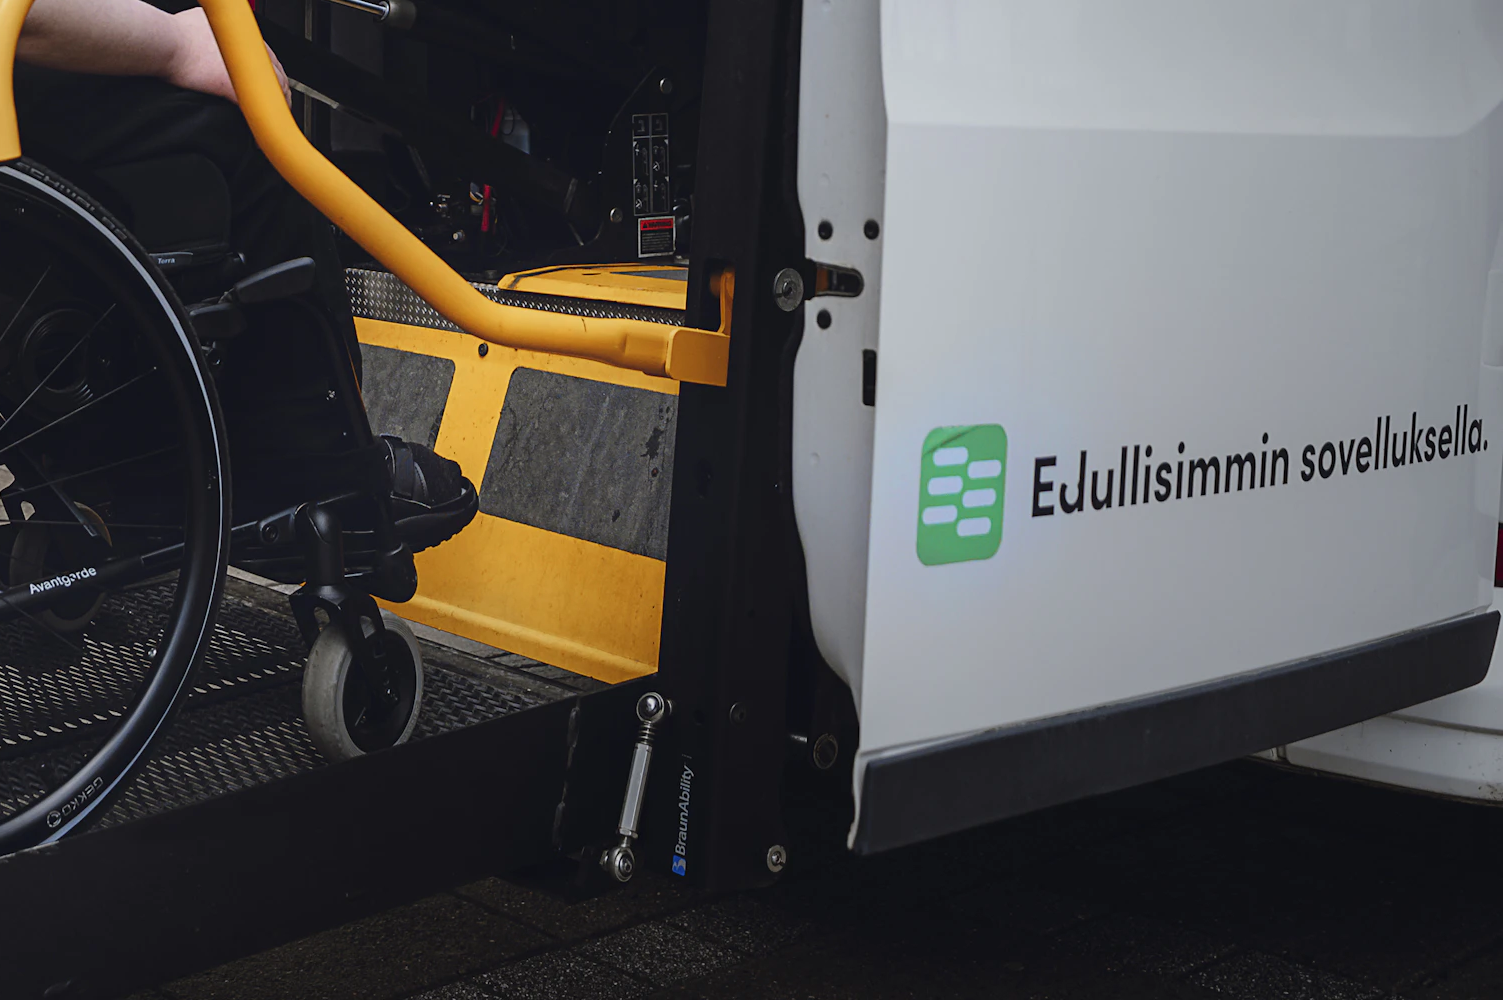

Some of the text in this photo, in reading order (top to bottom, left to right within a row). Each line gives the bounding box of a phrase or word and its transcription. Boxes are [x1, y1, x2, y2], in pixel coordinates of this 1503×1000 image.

[1031, 404, 1489, 518] Edullisimmin sovelluksella.
[61, 776, 104, 816] GEKKO
[675, 765, 695, 856] BraunAbility
